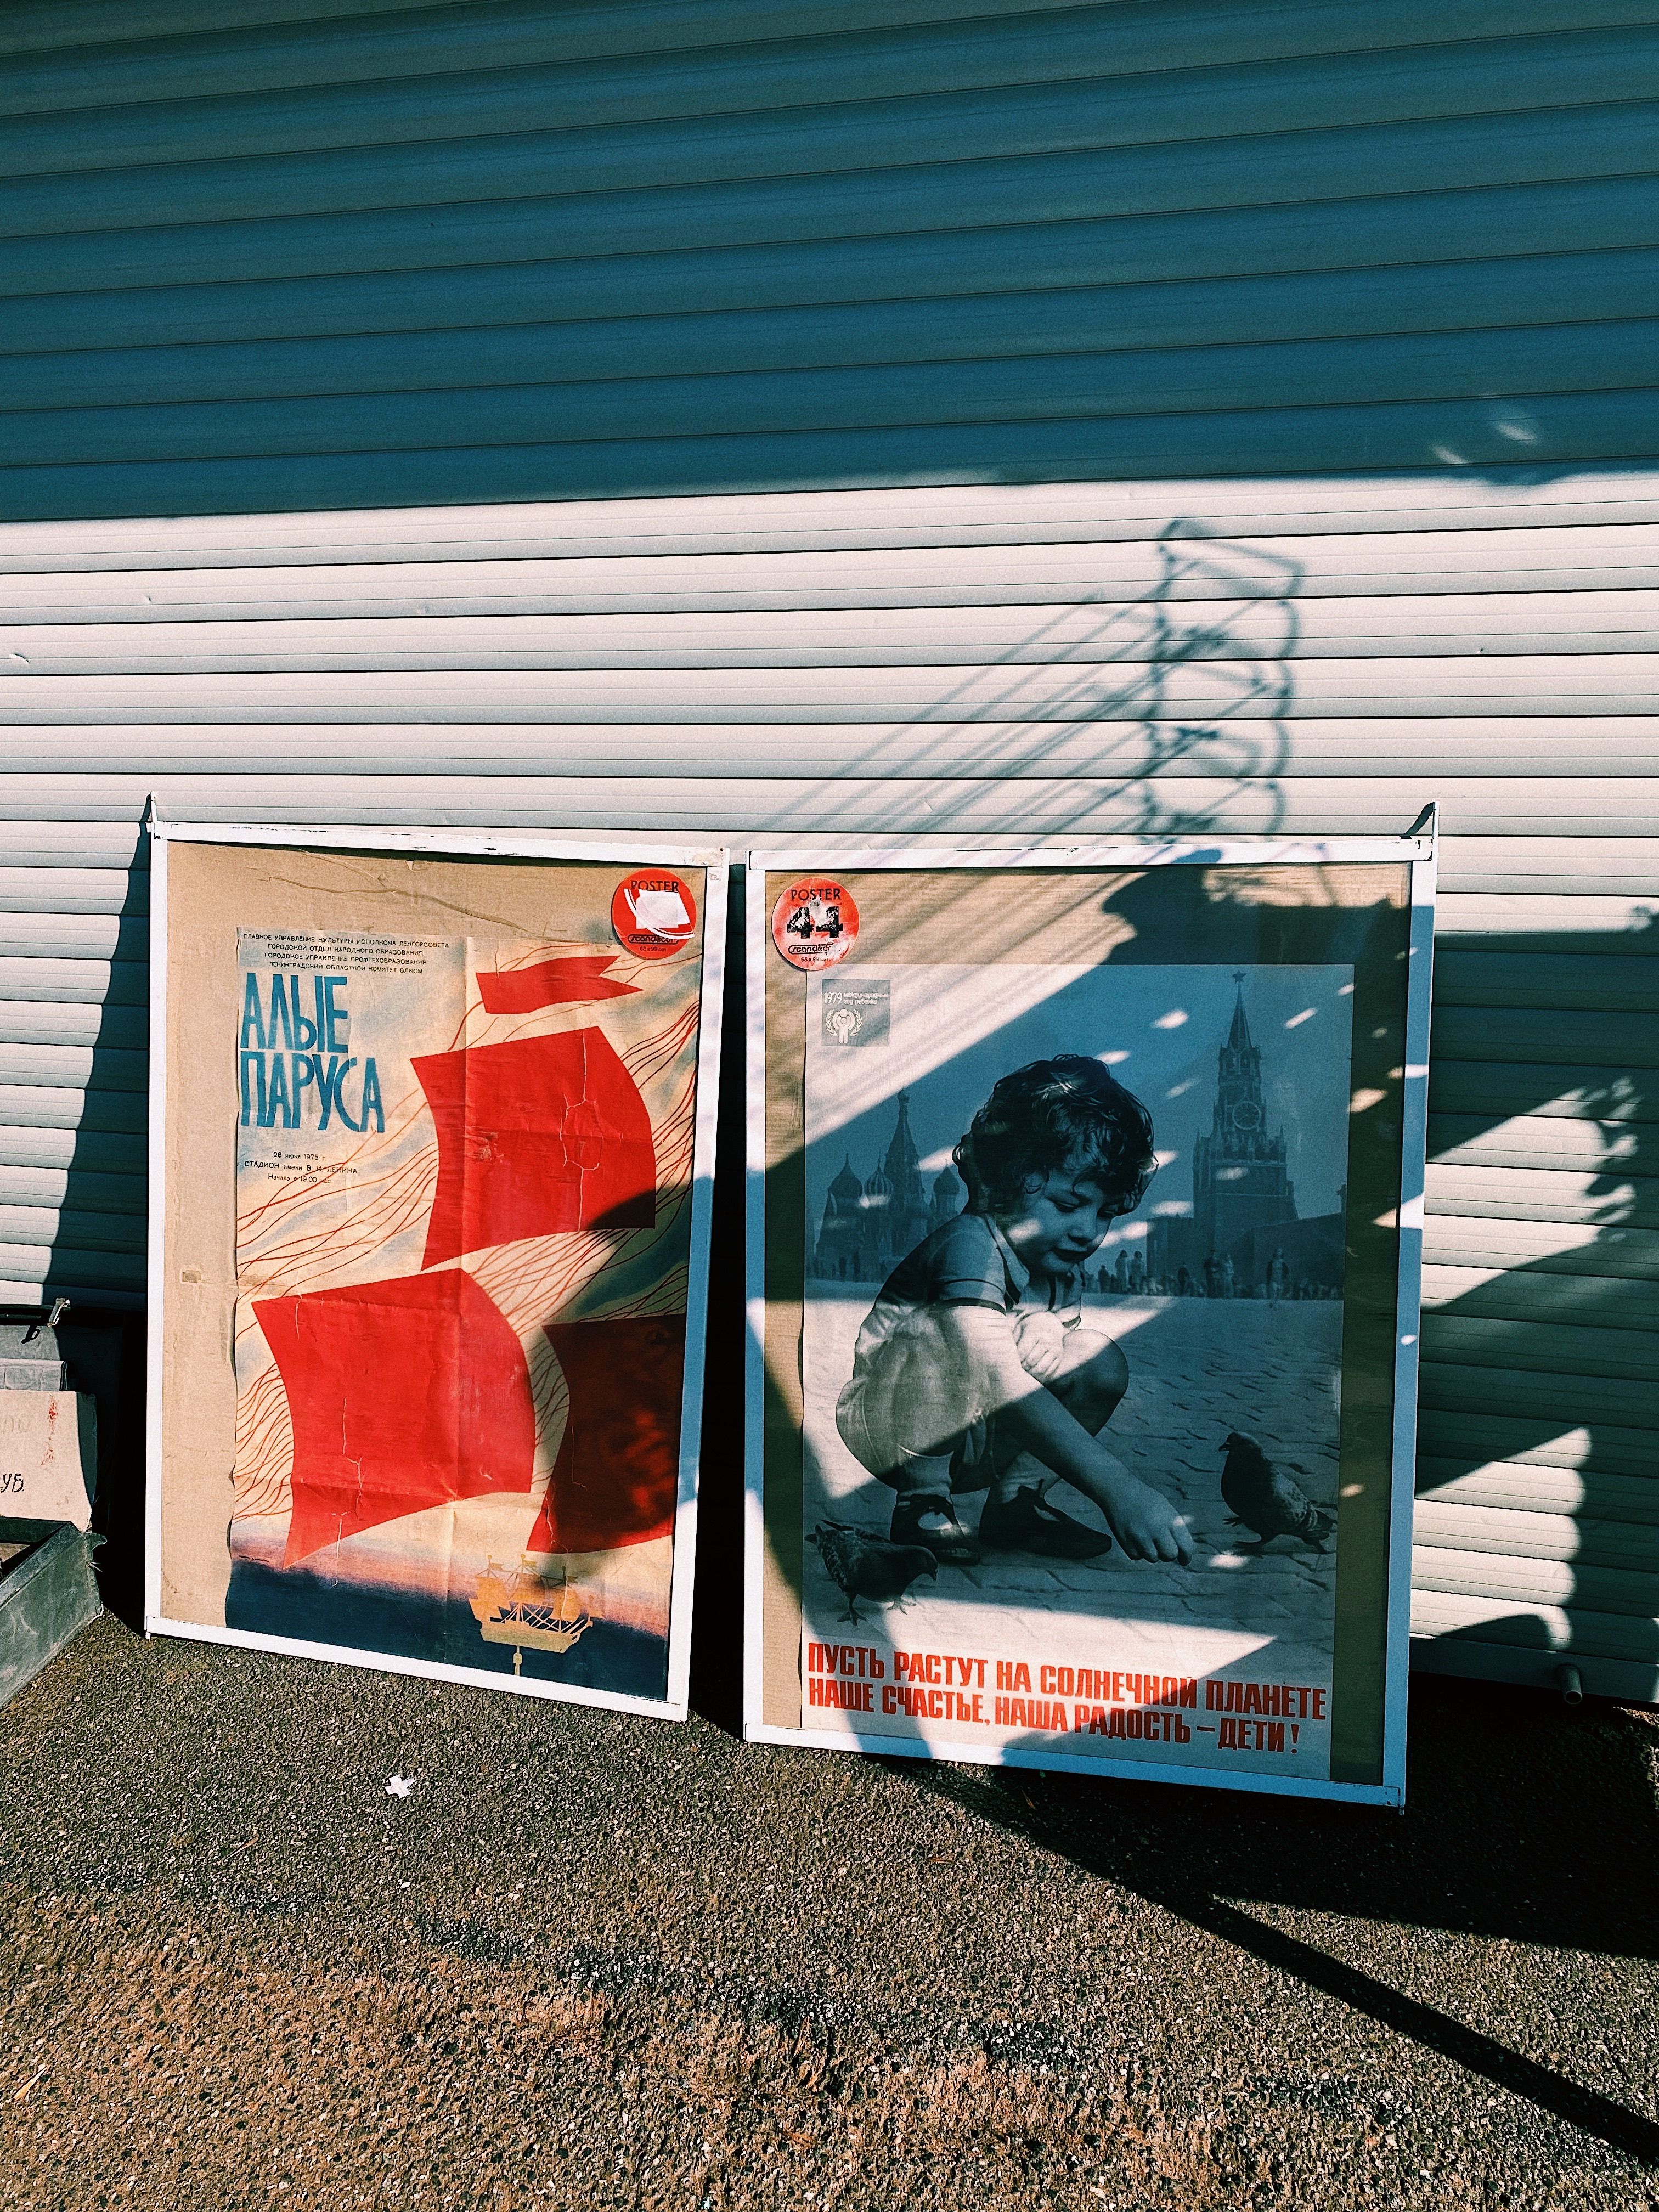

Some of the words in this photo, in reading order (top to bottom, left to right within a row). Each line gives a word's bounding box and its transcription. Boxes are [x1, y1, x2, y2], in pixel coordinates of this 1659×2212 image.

[631, 880, 679, 892] POSTER
[790, 888, 842, 901] POSTER
[787, 906, 843, 939] 44
[790, 945, 832, 953] scandec
[269, 961, 323, 969] ЛЕНИНГРАДСКИЙ
[351, 957, 427, 965] ПРОФТЕХОБРАЗОВАНИЯ
[823, 992, 843, 1004] 1979
[240, 972, 348, 1053] АЛЫЕ
[240, 1050, 385, 1133] ПАРУСА
[244, 1160, 279, 1169] СТАДИОН
[808, 1643, 885, 1679] ПУСТЬ
[894, 1651, 988, 1688] РАСТУТ
[996, 1661, 1031, 1692] НА
[1040, 1665, 1198, 1709] СОЛНЕЧНОЙ
[1206, 1679, 1327, 1720] ПЛАНЕТЕ
[809, 1678, 874, 1712] НАШЕ
[882, 1685, 990, 1726] СЧАСТЬЕ,
[995, 1696, 1068, 1732] НАША
[1074, 1704, 1190, 1744] РАДОСТЬ
